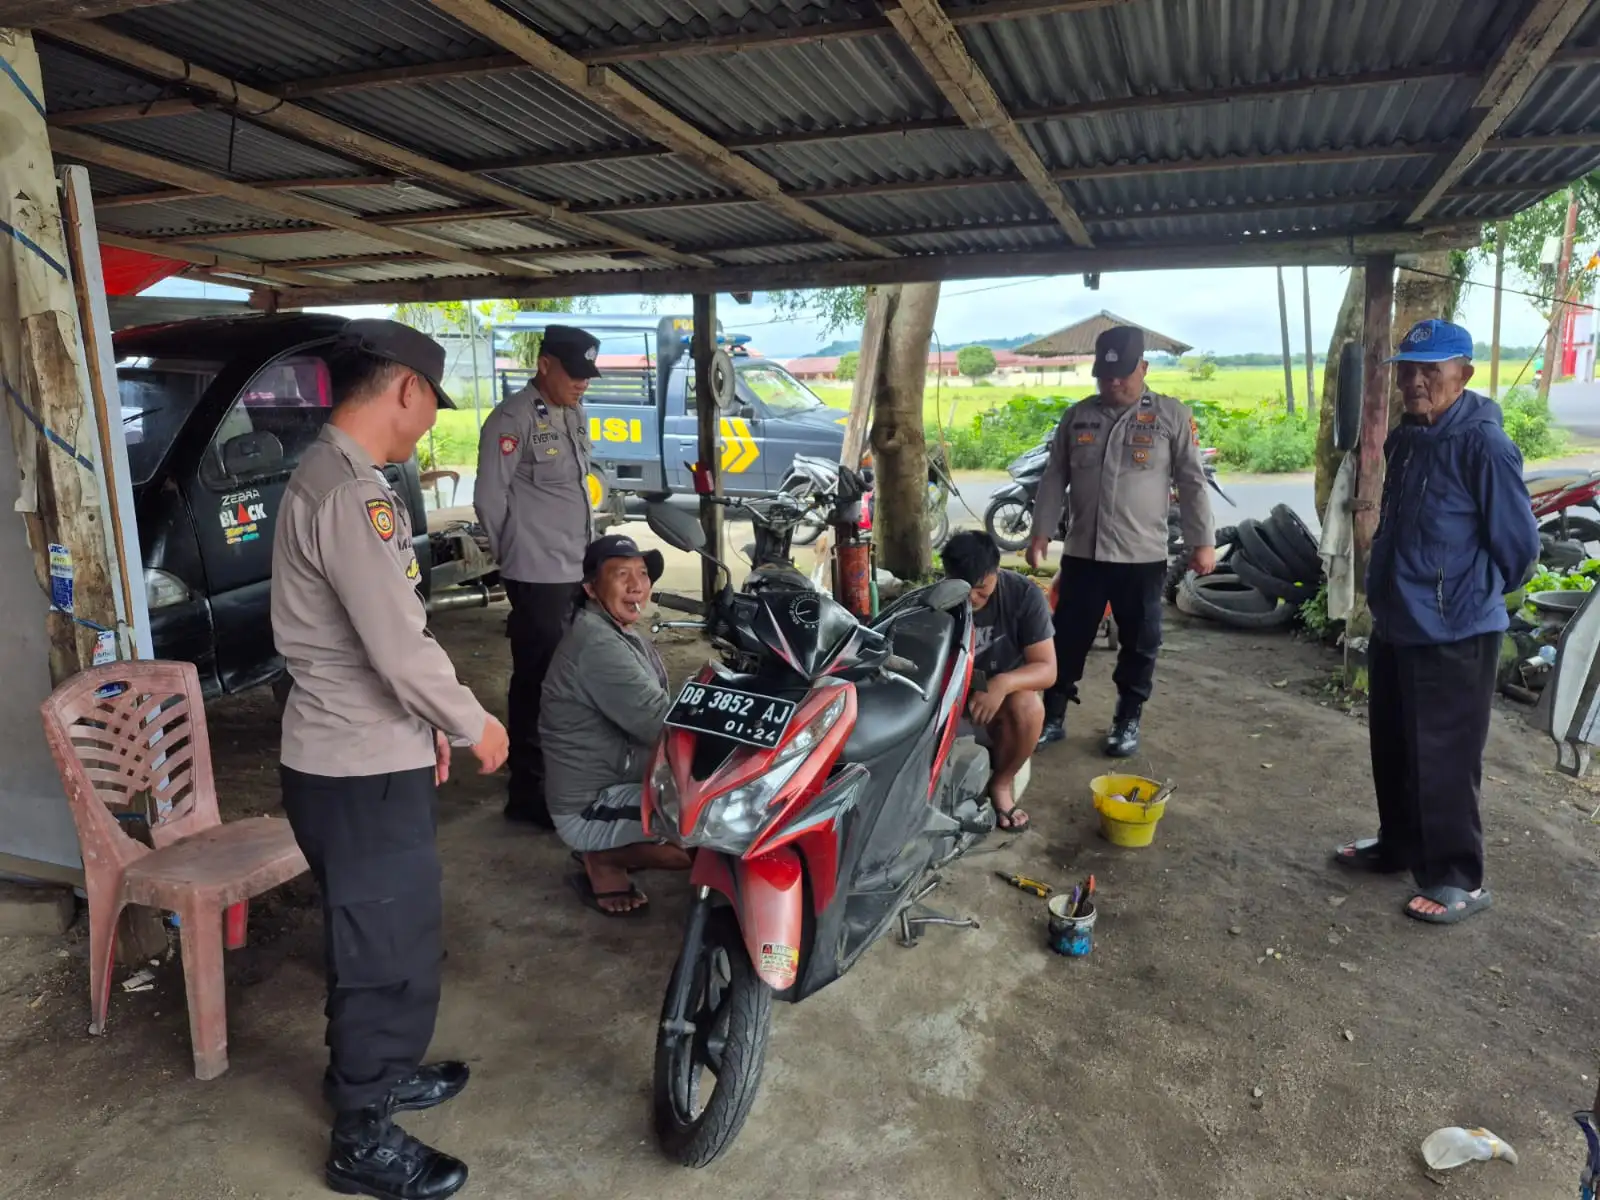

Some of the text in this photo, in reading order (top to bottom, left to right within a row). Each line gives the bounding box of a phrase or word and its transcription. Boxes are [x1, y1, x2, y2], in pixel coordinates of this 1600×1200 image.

[589, 417, 642, 442] ISI
[221, 489, 260, 506] ZEBRA
[680, 686, 790, 724] DB 3852 AJ
